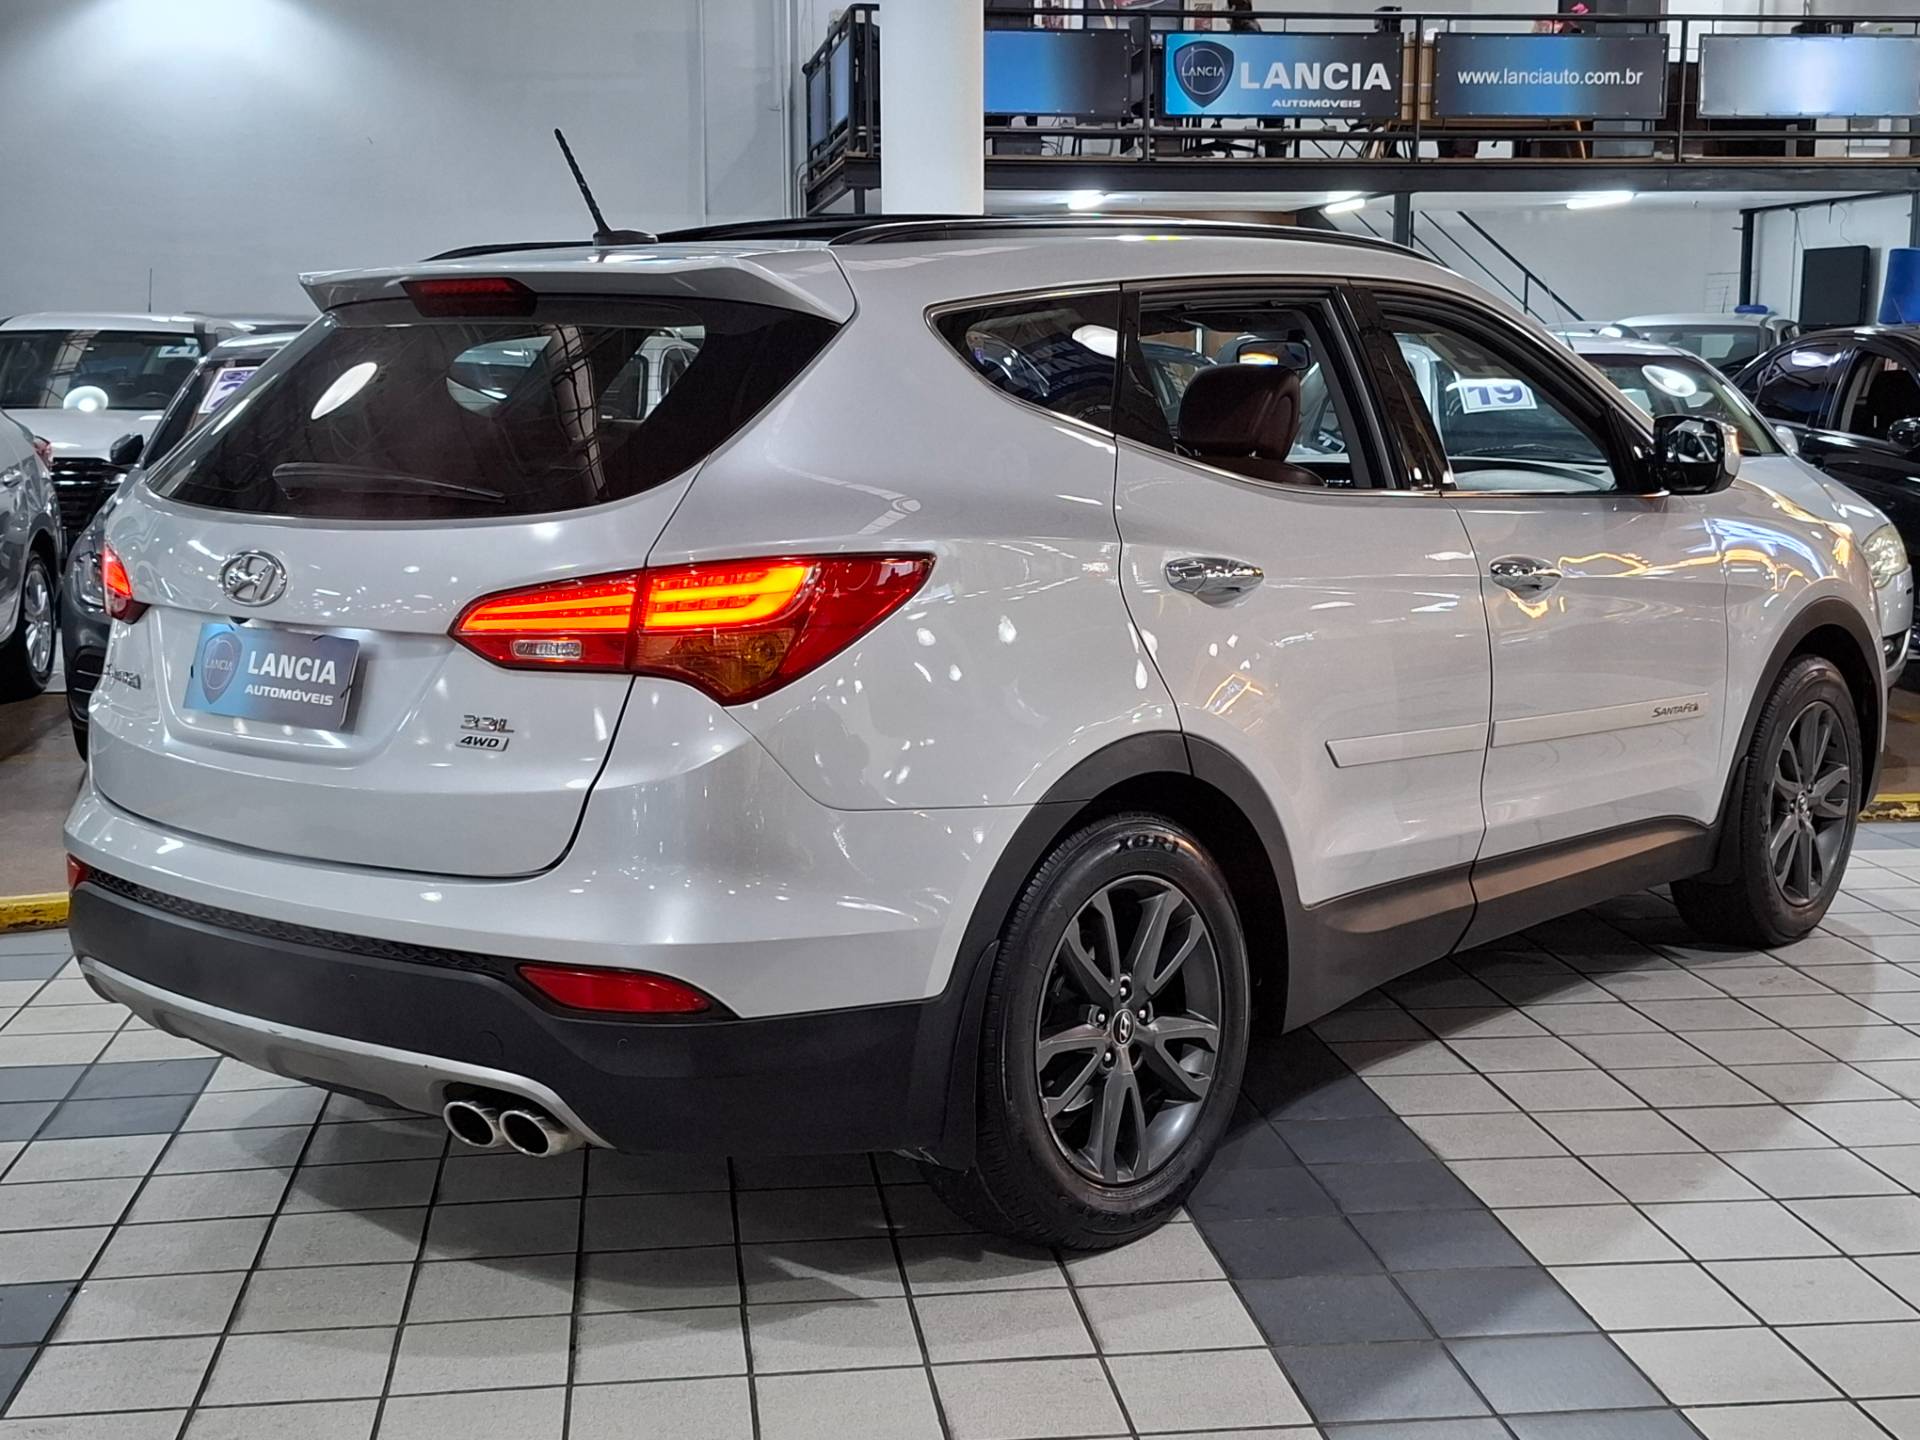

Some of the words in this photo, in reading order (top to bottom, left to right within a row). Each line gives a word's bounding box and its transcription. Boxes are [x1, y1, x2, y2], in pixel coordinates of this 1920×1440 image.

[1181, 66, 1224, 77] LANCIA
[1240, 62, 1392, 91] LANCIA
[1457, 68, 1644, 86] www.lanciauto.com.br
[1271, 98, 1361, 109] AUTOMÓVEIS
[205, 658, 234, 672] LANCIA
[247, 650, 337, 686] LANCIA
[244, 683, 334, 707] AUTOMÓVEIS
[460, 735, 500, 748] 4WD
